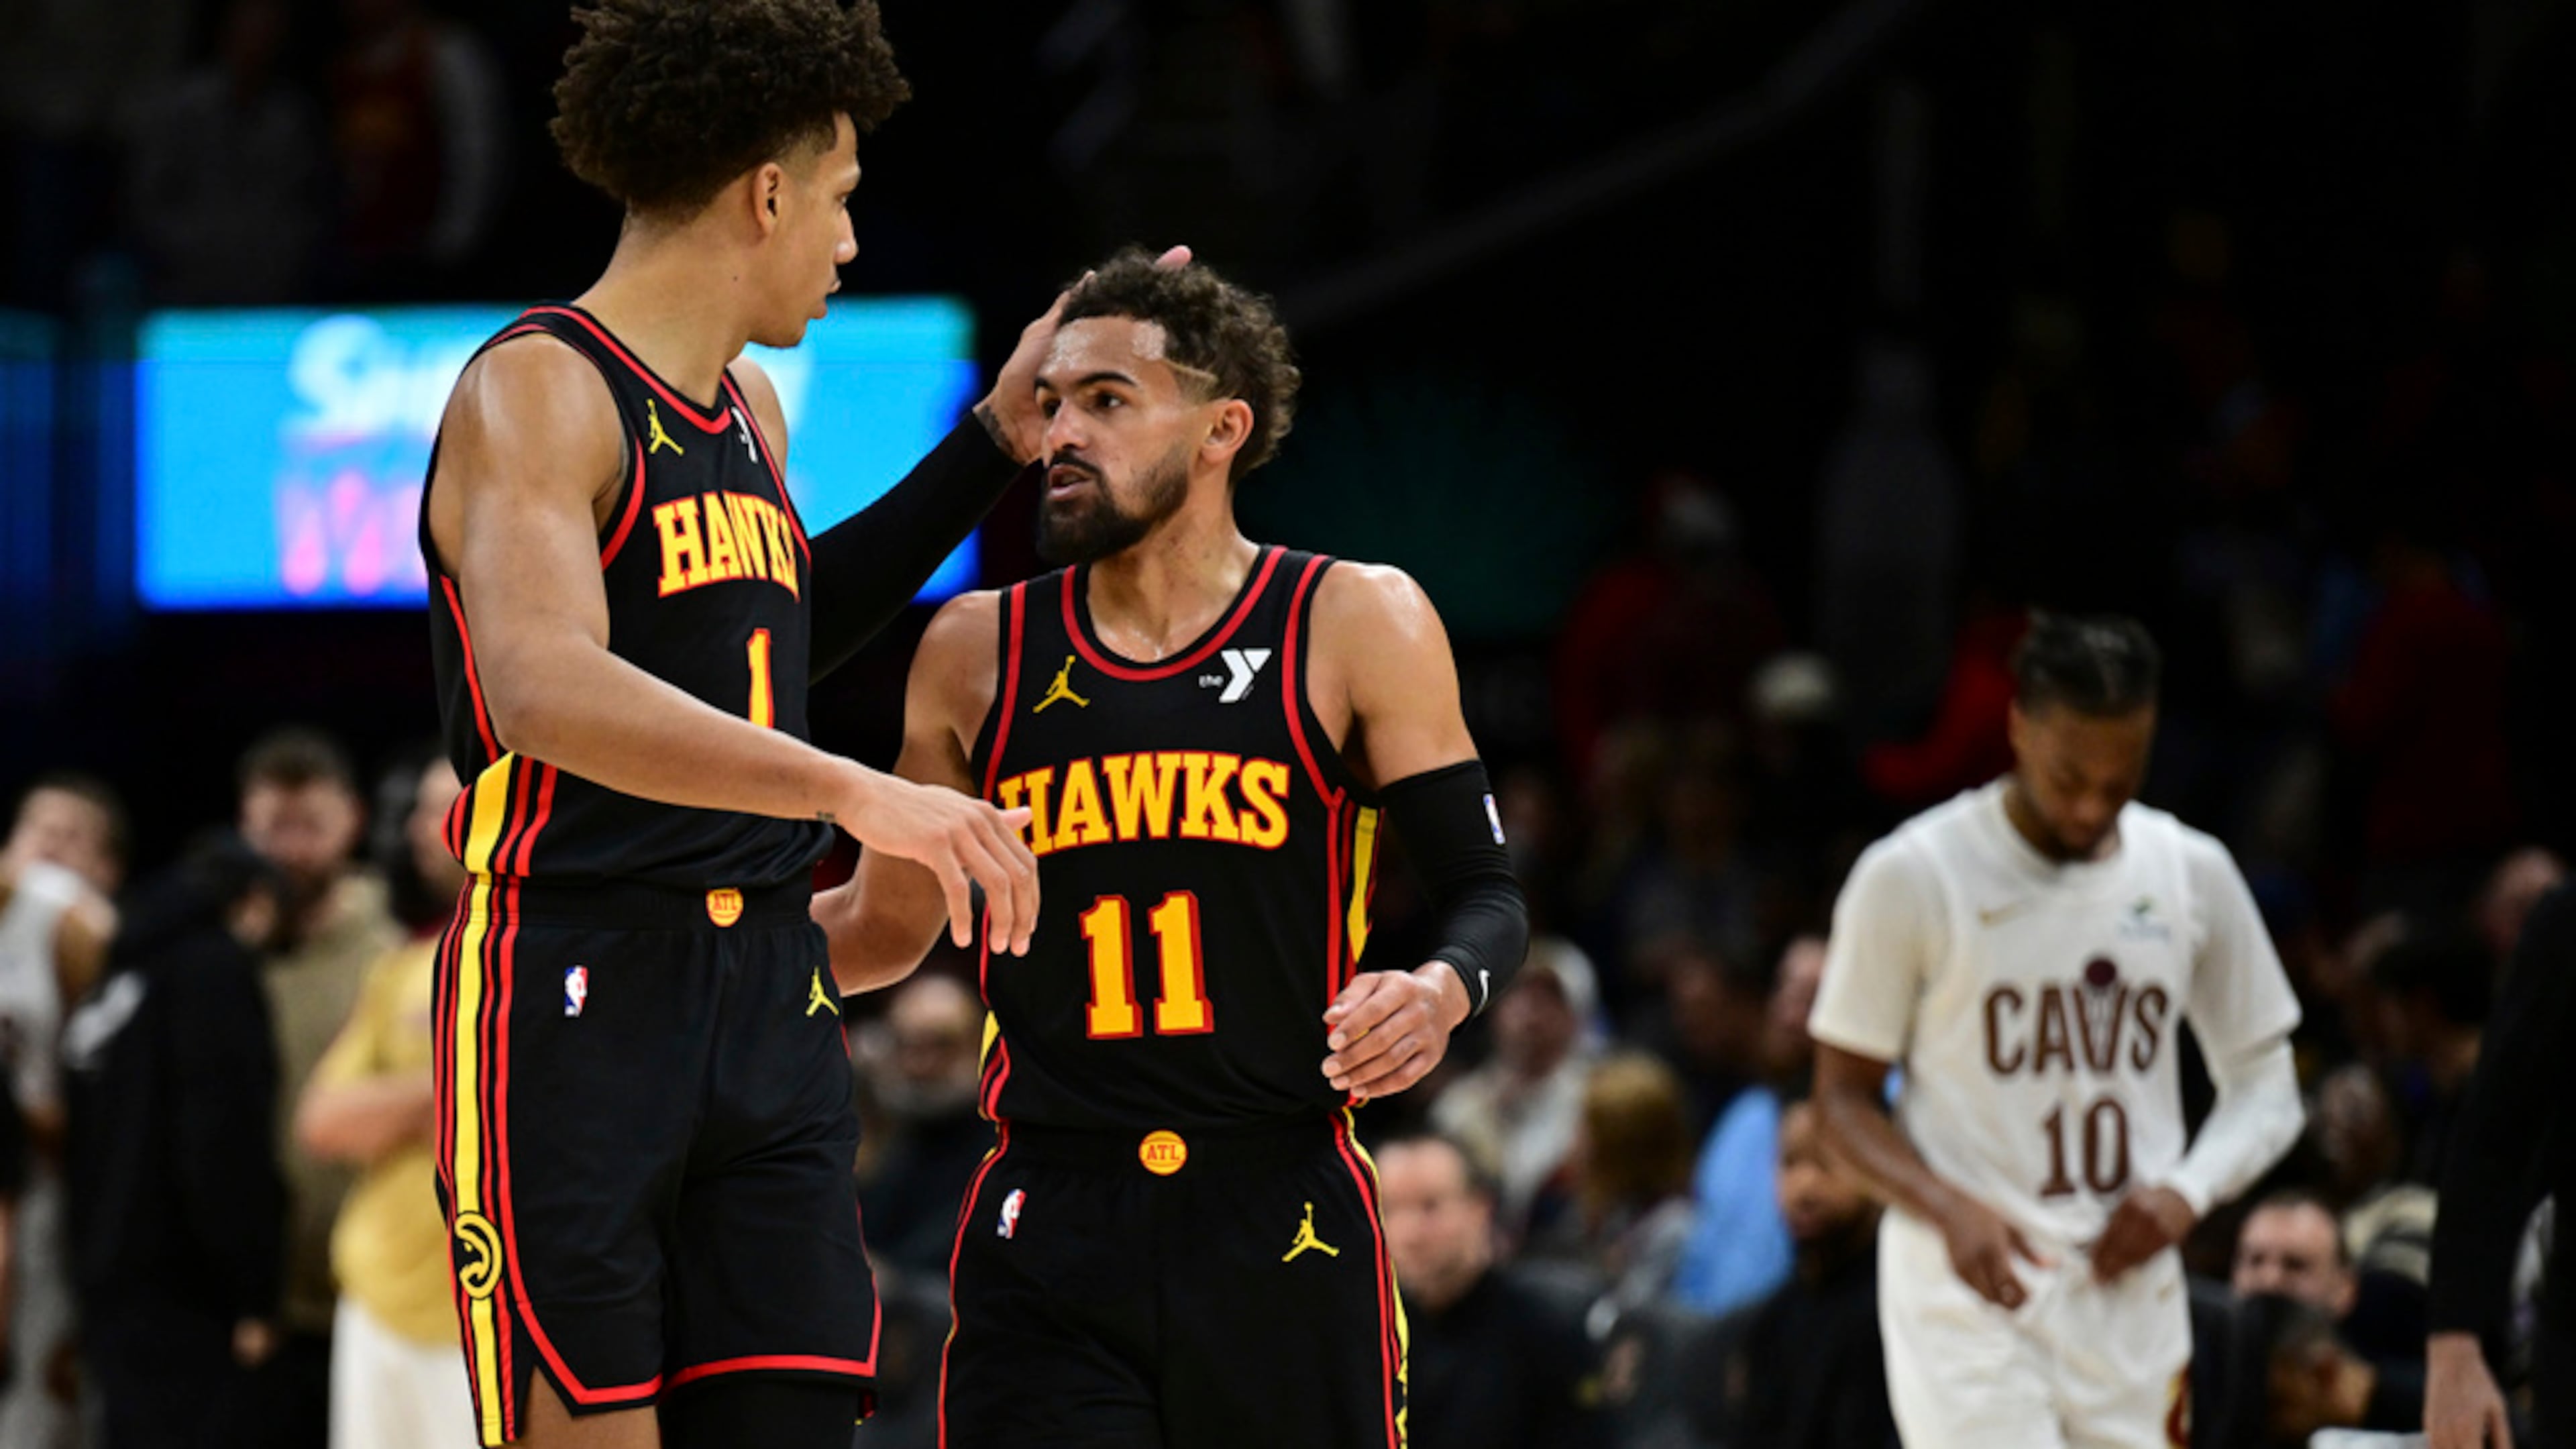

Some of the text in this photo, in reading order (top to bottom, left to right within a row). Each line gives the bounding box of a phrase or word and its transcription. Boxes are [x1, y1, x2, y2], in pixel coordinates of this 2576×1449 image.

[651, 489, 800, 602] HAWK
[745, 627, 775, 729] 1
[998, 750, 1291, 857] HAWKS
[714, 893, 737, 910] ATL
[1079, 890, 1215, 1040] 11
[1982, 982, 2169, 1077] CAVS
[1146, 1144, 1180, 1161] ATL
[2038, 1095, 2131, 1199] 10
